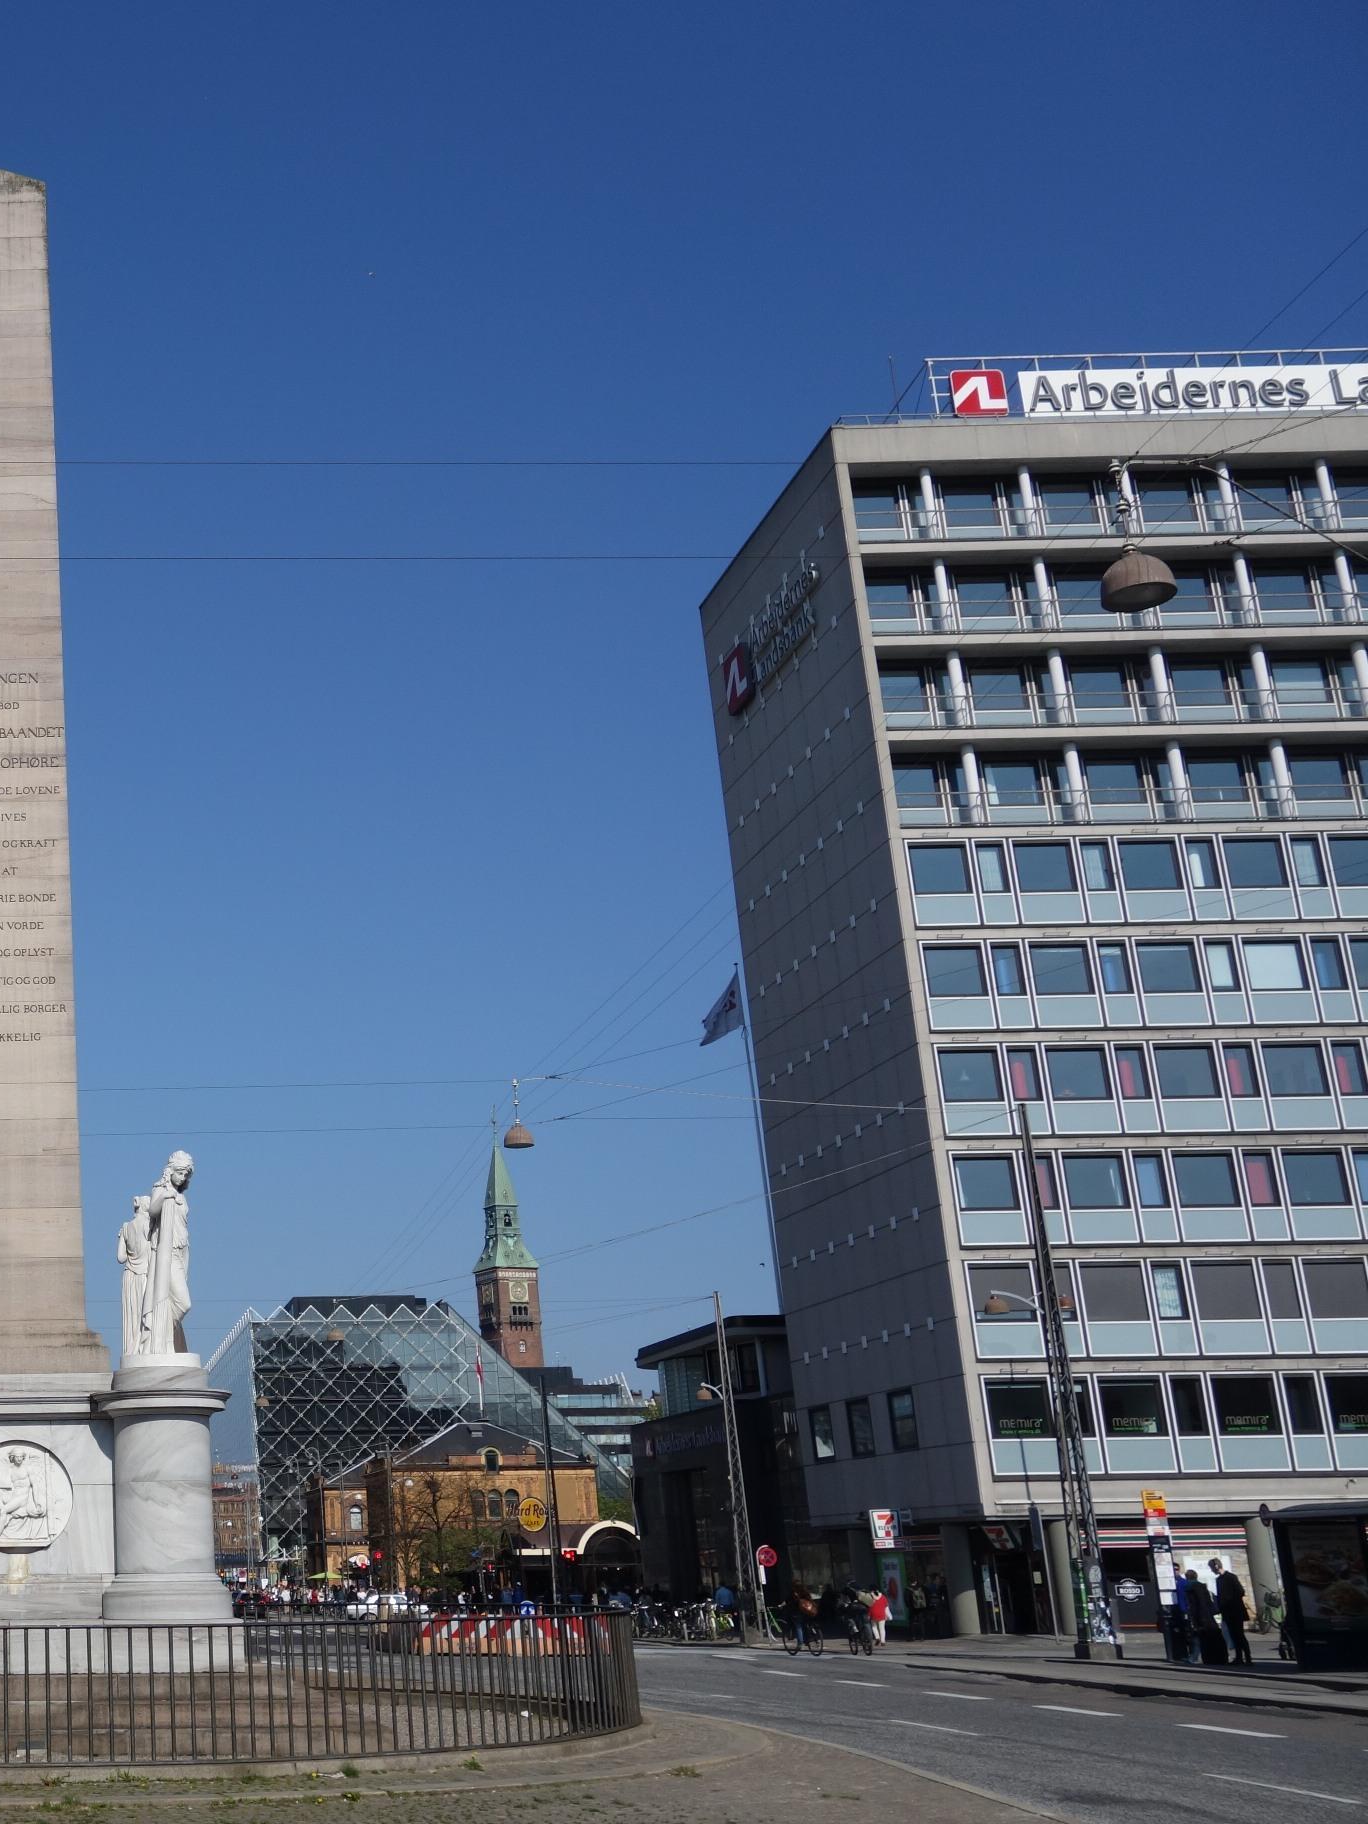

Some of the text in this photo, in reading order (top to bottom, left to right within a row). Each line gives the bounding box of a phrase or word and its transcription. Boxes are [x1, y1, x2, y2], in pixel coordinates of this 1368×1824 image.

[1029, 368, 1311, 414] Arbejdernes
[751, 563, 819, 651] Arbejdernes
[753, 604, 816, 685] Landsbank
[0, 756, 60, 769] OPHØRE
[16, 786, 61, 795] LOVENE
[2, 839, 19, 849] OG
[19, 839, 57, 848] KRAFT
[1, 867, 18, 876] AT
[18, 893, 57, 903] BONDE
[7, 921, 44, 930] VORDE
[13, 948, 55, 957] OPLYST
[15, 977, 31, 985] OG
[32, 976, 56, 985] GOD
[23, 1004, 67, 1014] BORGER
[999, 1417, 1042, 1428] memira
